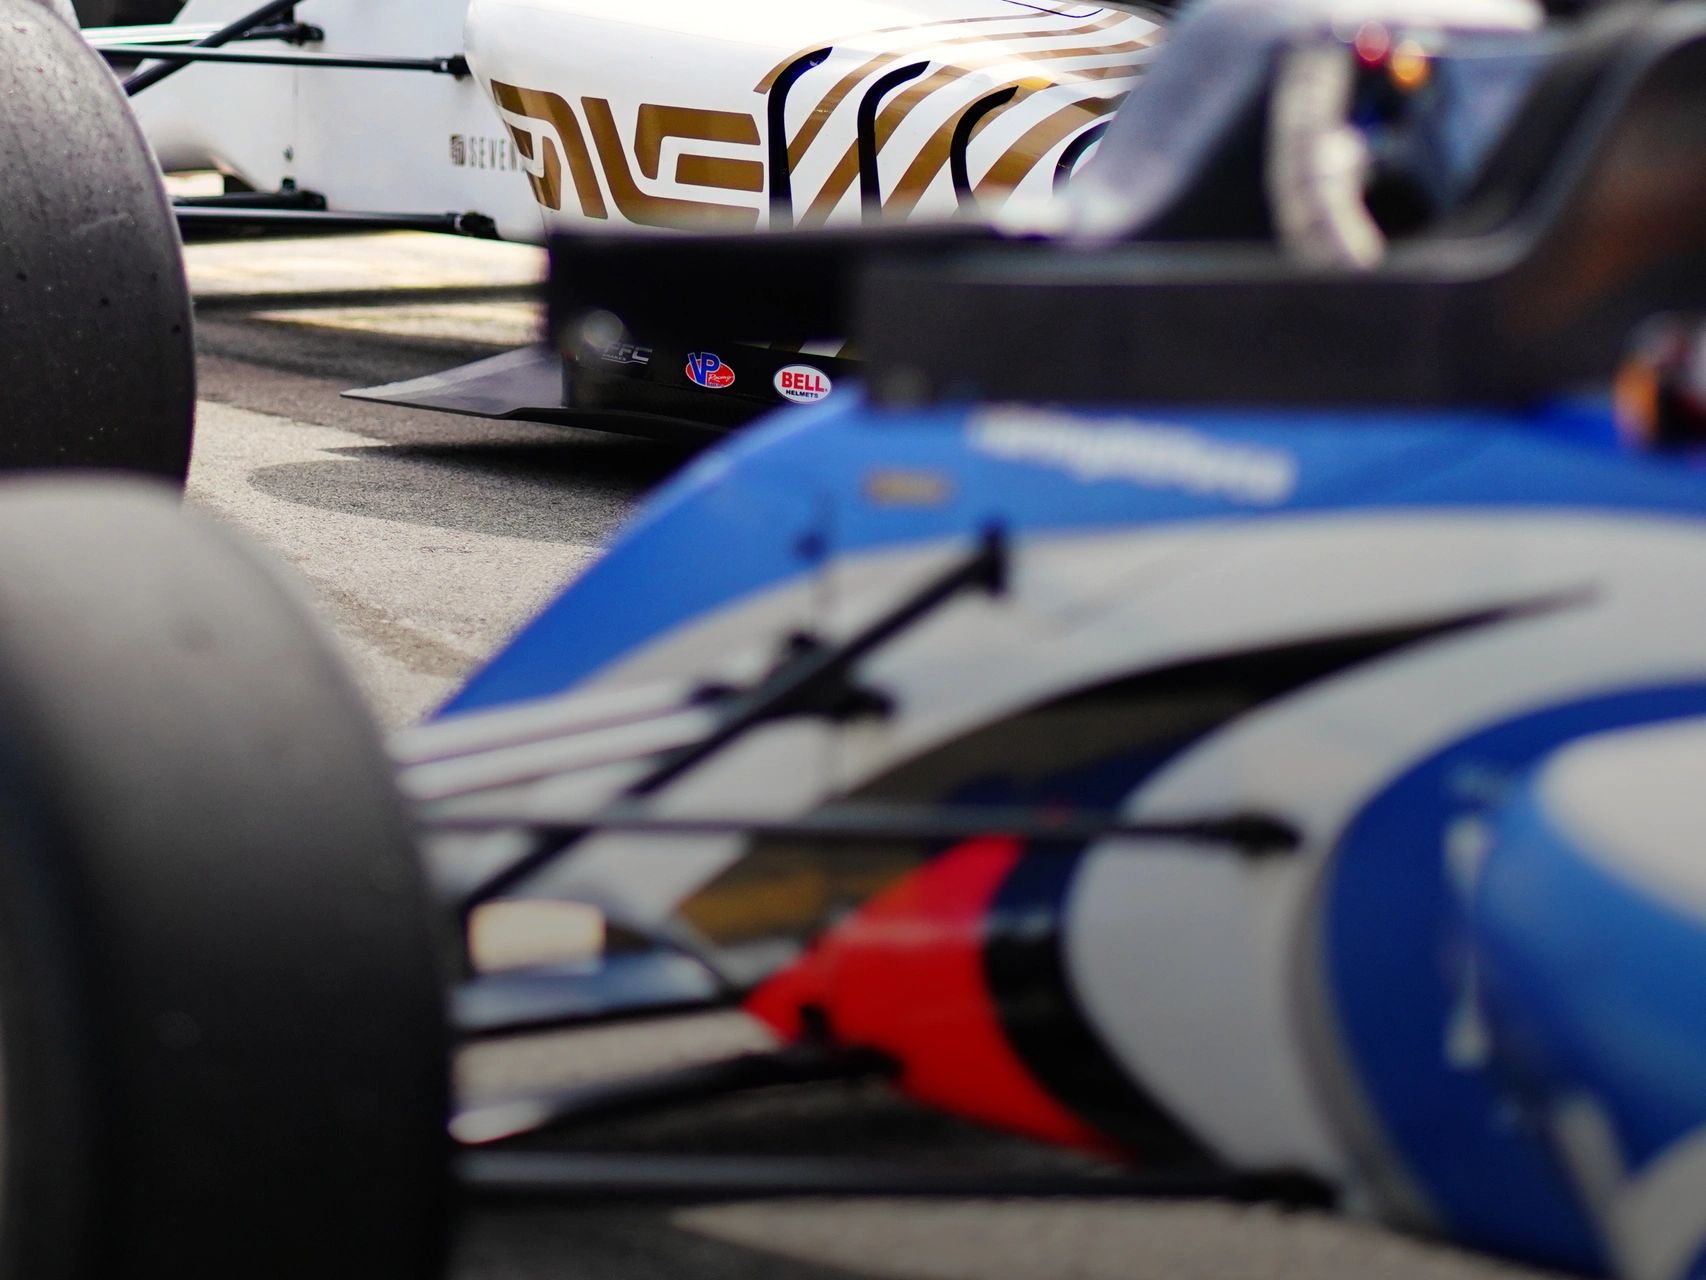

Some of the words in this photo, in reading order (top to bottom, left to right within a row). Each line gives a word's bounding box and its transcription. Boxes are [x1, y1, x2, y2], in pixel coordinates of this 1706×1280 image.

[688, 353, 720, 385] VP
[781, 371, 825, 393] BELL
[785, 389, 819, 399] HELMETS
